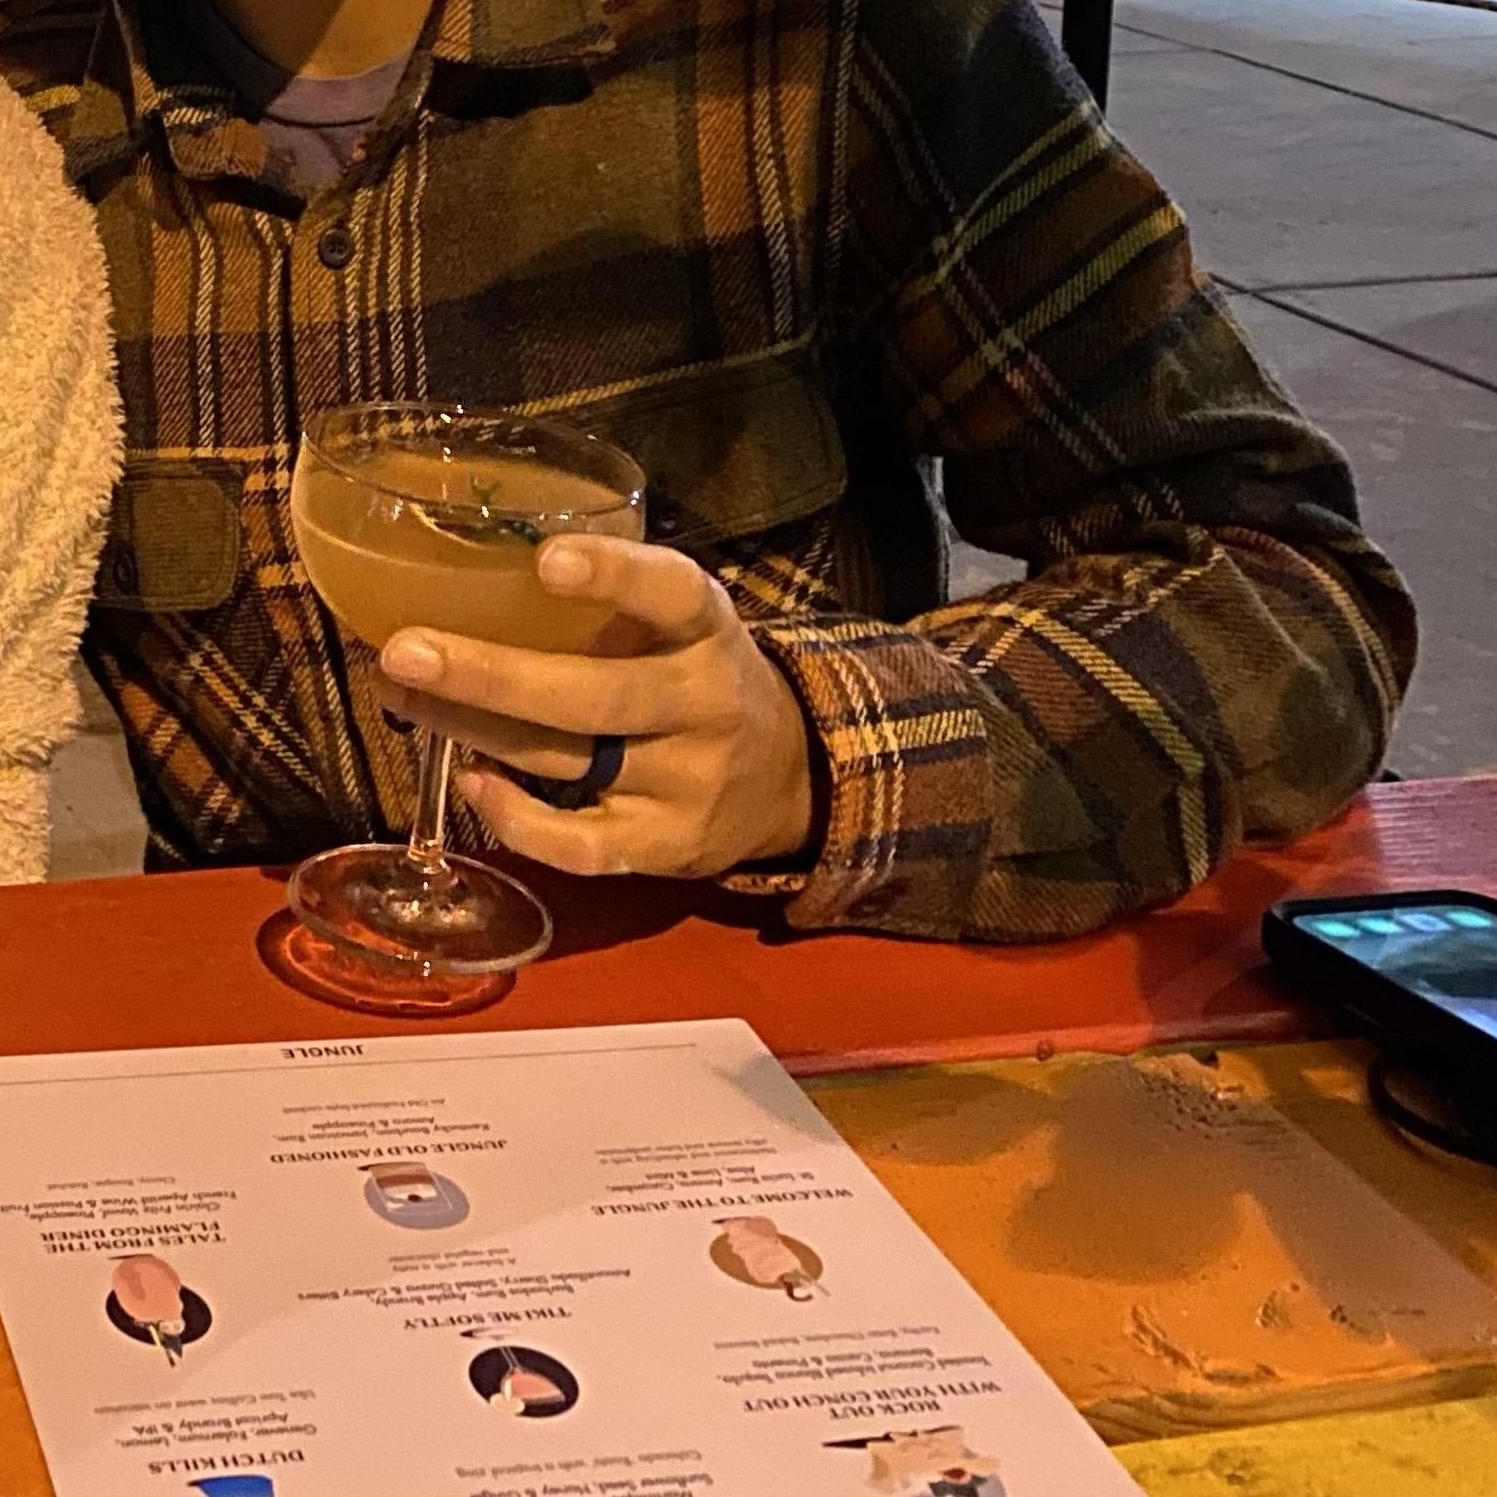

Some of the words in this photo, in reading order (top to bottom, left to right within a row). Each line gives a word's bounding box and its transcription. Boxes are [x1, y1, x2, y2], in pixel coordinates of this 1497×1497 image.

[281, 1045, 364, 1059] JUNGLE
[312, 1119, 375, 1130] Pineapple
[372, 1126, 430, 1136] Bourbon,
[433, 1122, 490, 1134] Kentucky
[273, 1134, 306, 1144] Rum,
[308, 1130, 368, 1141] Jamaican
[387, 1145, 428, 1156] OLD
[431, 1139, 507, 1153] JUNGLE
[269, 1147, 382, 1164] FASHIONED
[192, 1190, 236, 1200] French
[719, 1195, 750, 1207] TO
[750, 1188, 852, 1206] WELCOME
[33, 1200, 83, 1211] Passion
[86, 1199, 97, 1208] &
[101, 1197, 138, 1207] Wine
[590, 1200, 669, 1216] JUNGLE
[670, 1196, 718, 1210] THE
[0, 1204, 30, 1214] Fruit
[24, 1210, 95, 1222] Pineapple,
[110, 1220, 221, 1237] FLAMINGO
[40, 1229, 106, 1242] DINER
[158, 1232, 226, 1247] TALES
[44, 1242, 91, 1254] THE
[93, 1238, 154, 1250] FROM
[454, 1278, 496, 1290] Salted
[499, 1274, 548, 1287] Sherry,
[342, 1287, 387, 1299] Celery
[390, 1286, 402, 1294] &
[297, 1292, 340, 1302] Bitters
[370, 1295, 425, 1308] Brandy,
[427, 1291, 467, 1304] Apple
[487, 1310, 521, 1322] ME
[524, 1306, 571, 1321] TIKI
[403, 1312, 485, 1330] SOFTLY
[872, 1385, 936, 1402] YOUR
[934, 1380, 1002, 1396] WITH
[742, 1398, 790, 1412] OUT
[792, 1390, 870, 1408] CONCH
[829, 1404, 875, 1420] OUT
[878, 1400, 942, 1417] ROCK
[178, 1416, 232, 1431] Brandy
[235, 1411, 288, 1426] Apricot
[131, 1424, 157, 1435] IPA
[160, 1422, 174, 1433] &
[250, 1423, 317, 1436] Genever,
[115, 1436, 170, 1448] Lemon,
[220, 1449, 305, 1468] DUTCH
[147, 1457, 216, 1475] KILLS
